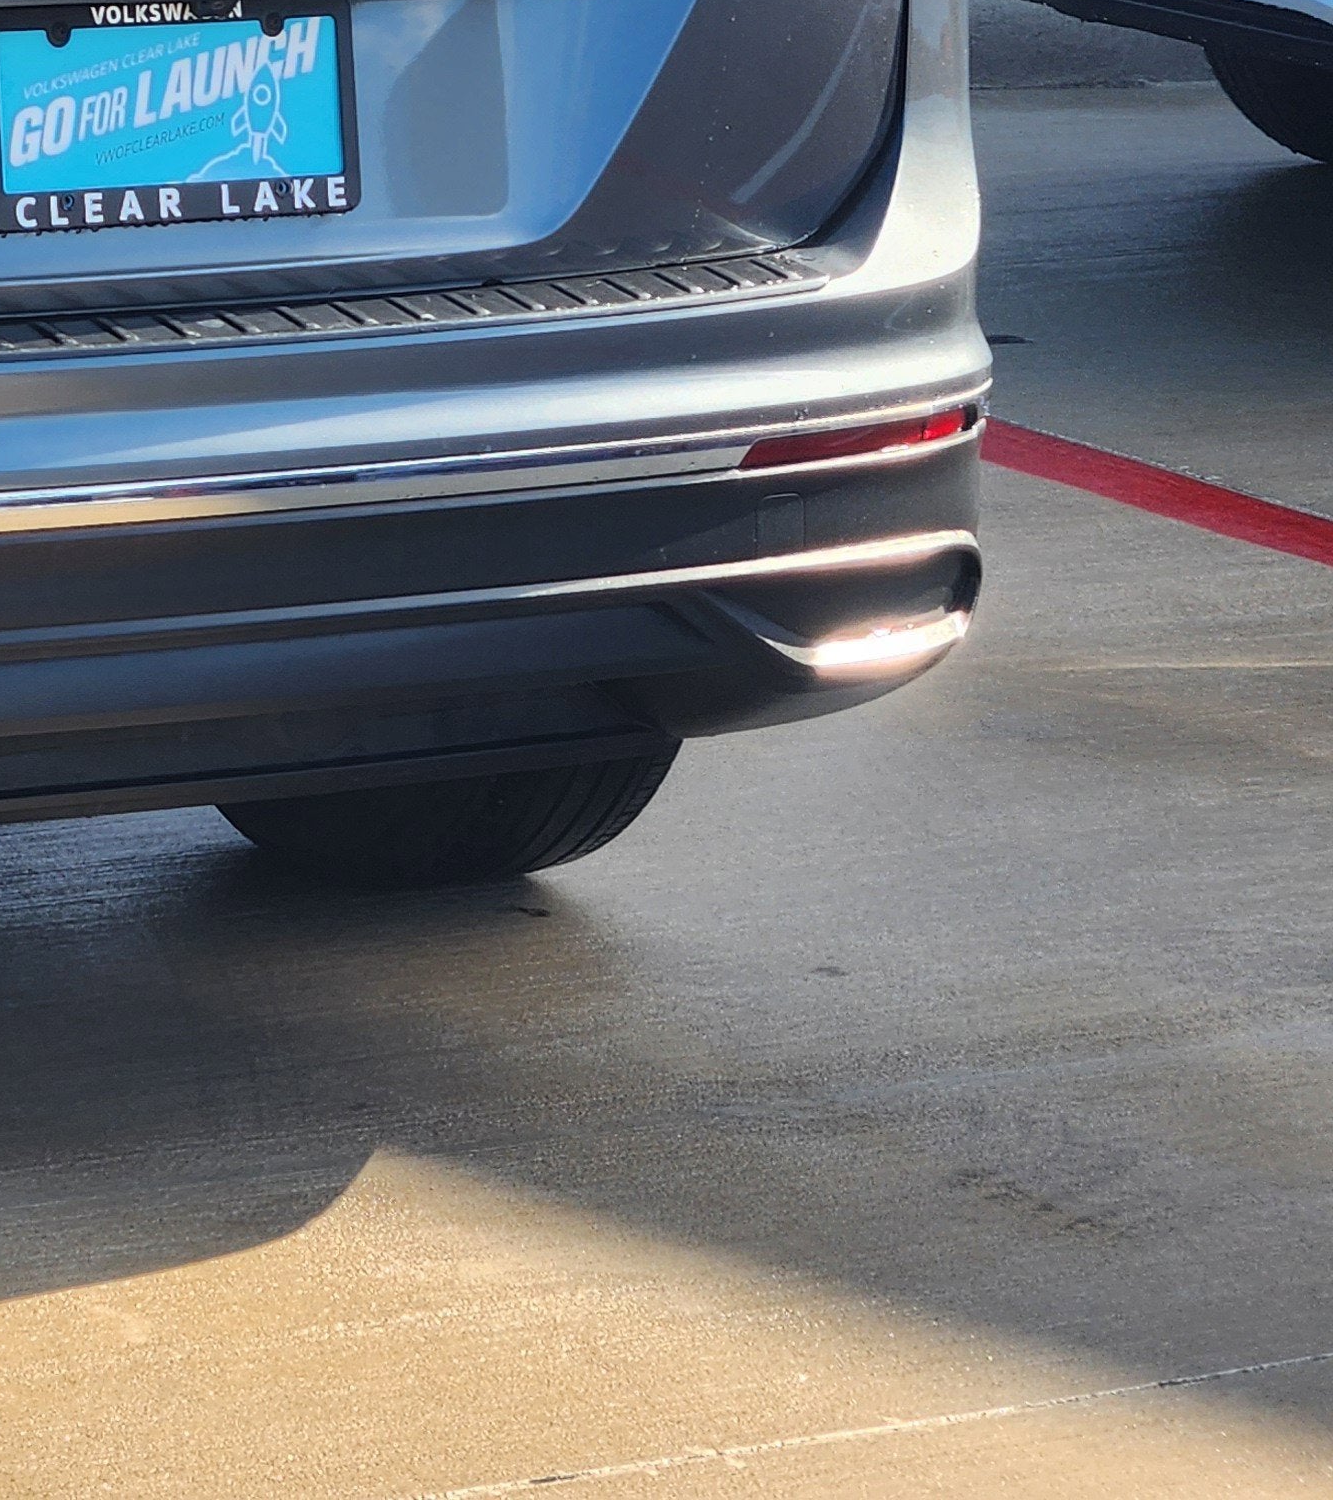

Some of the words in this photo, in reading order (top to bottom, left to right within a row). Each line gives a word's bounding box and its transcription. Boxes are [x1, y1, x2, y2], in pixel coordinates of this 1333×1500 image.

[90, 0, 243, 25] VOLKSWAN
[8, 96, 77, 168] GO
[78, 86, 128, 142] FOR
[133, 16, 321, 129] LAUNCH
[23, 57, 118, 100] VOLKSWAGEN
[120, 46, 164, 70] CLEAR
[167, 32, 201, 55] LAKE
[95, 113, 226, 166] VWOFCLEARLAKE.COM
[15, 186, 182, 229] CLEAR
[221, 176, 348, 215] LAKE
